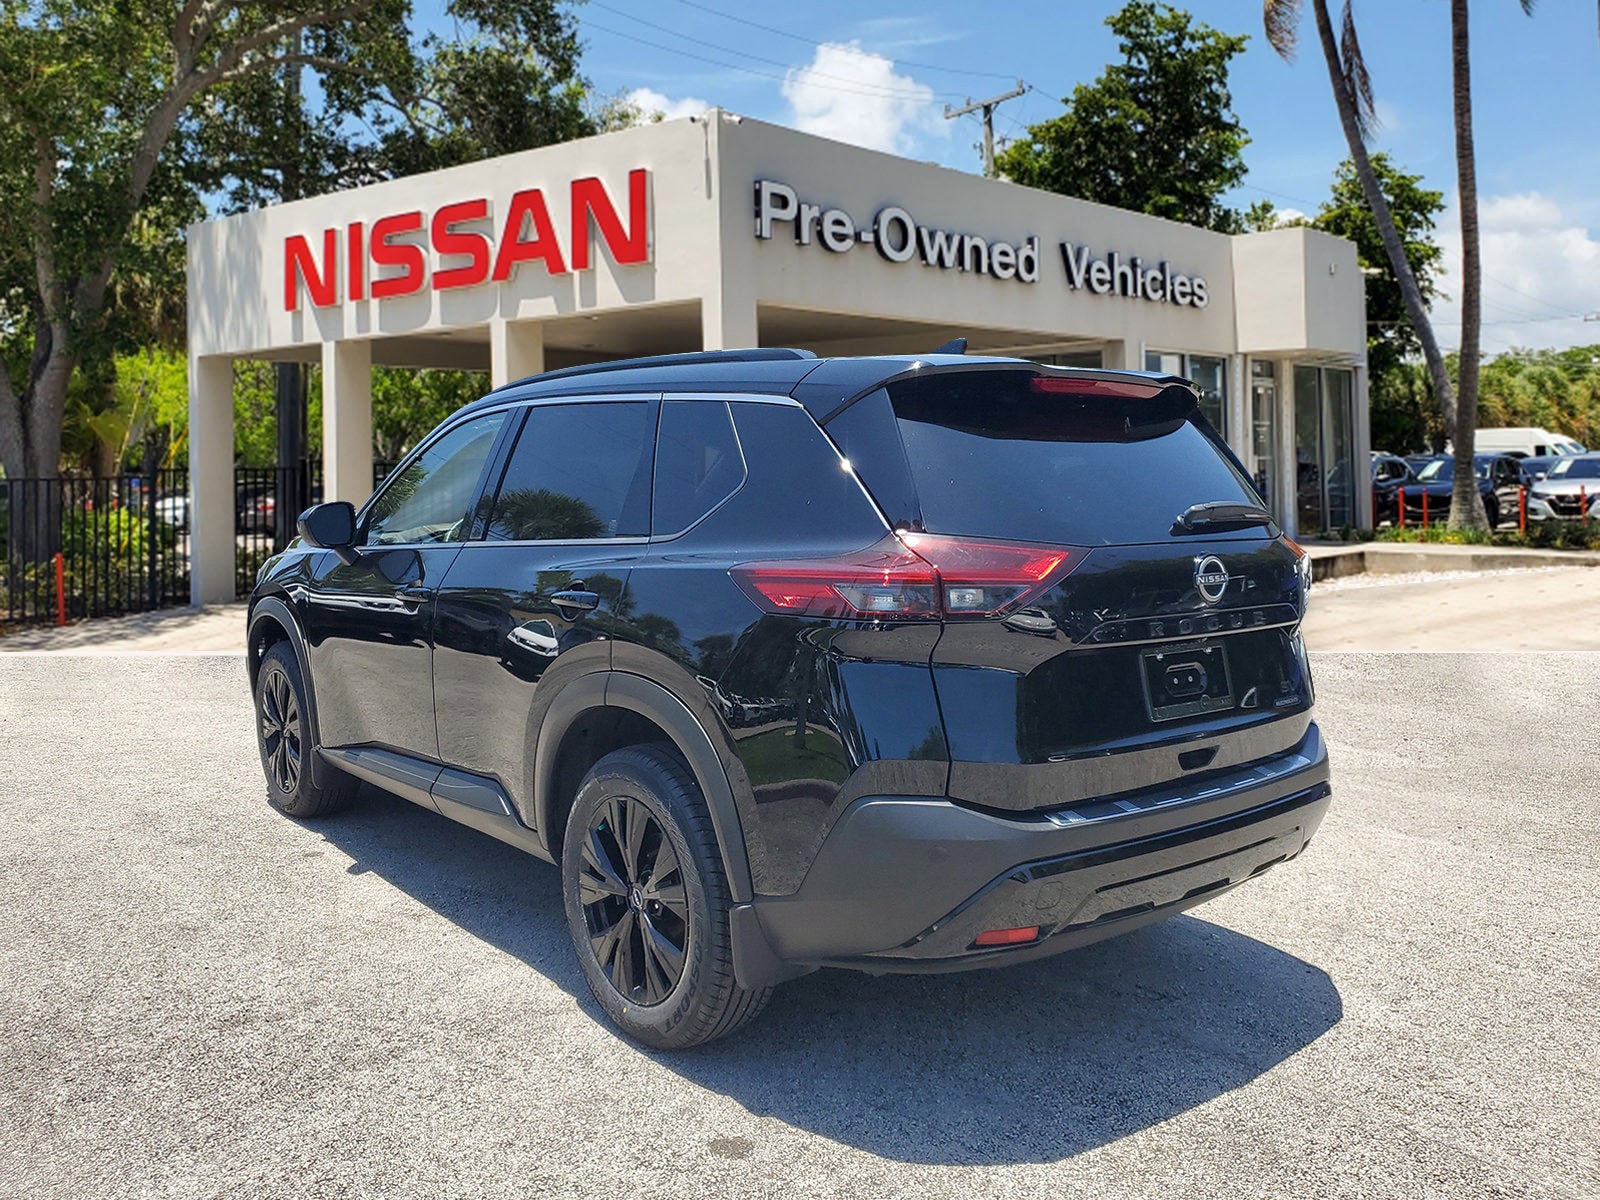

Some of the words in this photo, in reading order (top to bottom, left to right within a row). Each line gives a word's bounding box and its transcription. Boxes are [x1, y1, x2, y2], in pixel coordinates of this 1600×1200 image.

[284, 168, 648, 312] NISSAN
[754, 179, 1040, 284] Pre-Owned
[1060, 240, 1209, 309] Vehicles
[1197, 574, 1228, 583] NISSAN
[1150, 610, 1267, 636] ROGUE
